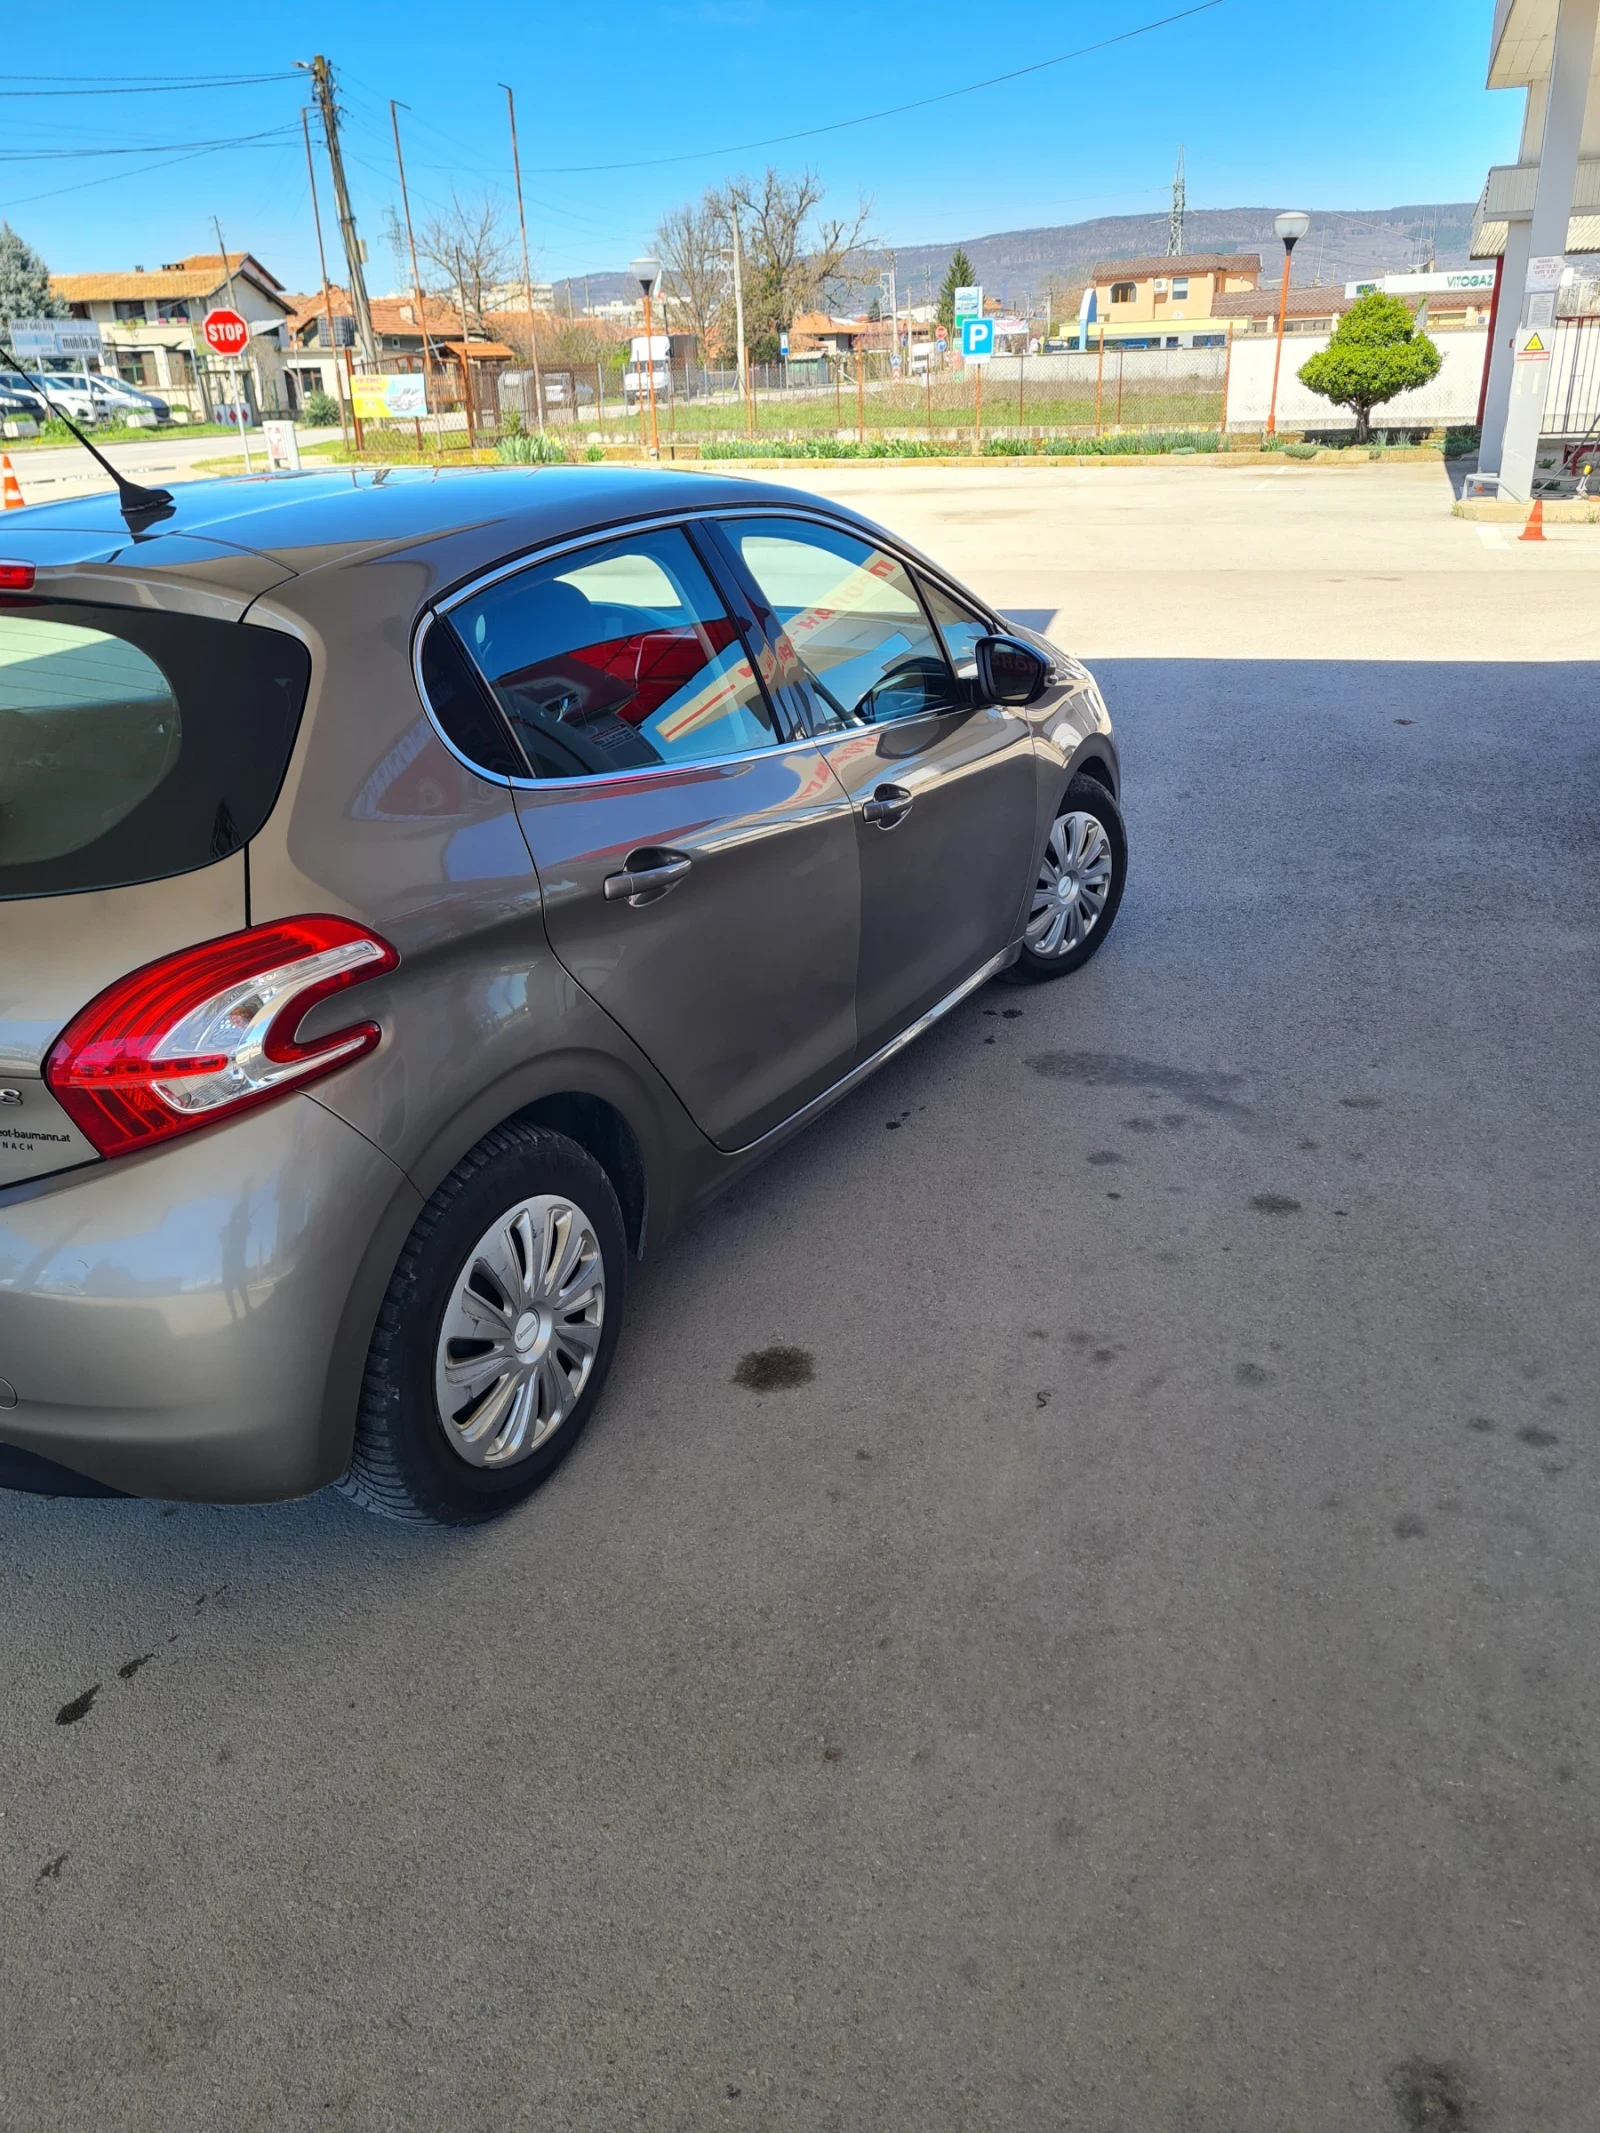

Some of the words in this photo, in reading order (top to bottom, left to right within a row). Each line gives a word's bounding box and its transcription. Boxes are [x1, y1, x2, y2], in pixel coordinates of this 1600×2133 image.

[1447, 274, 1494, 288] VITOGAZ
[207, 323, 244, 342] STOP
[969, 324, 989, 351] P
